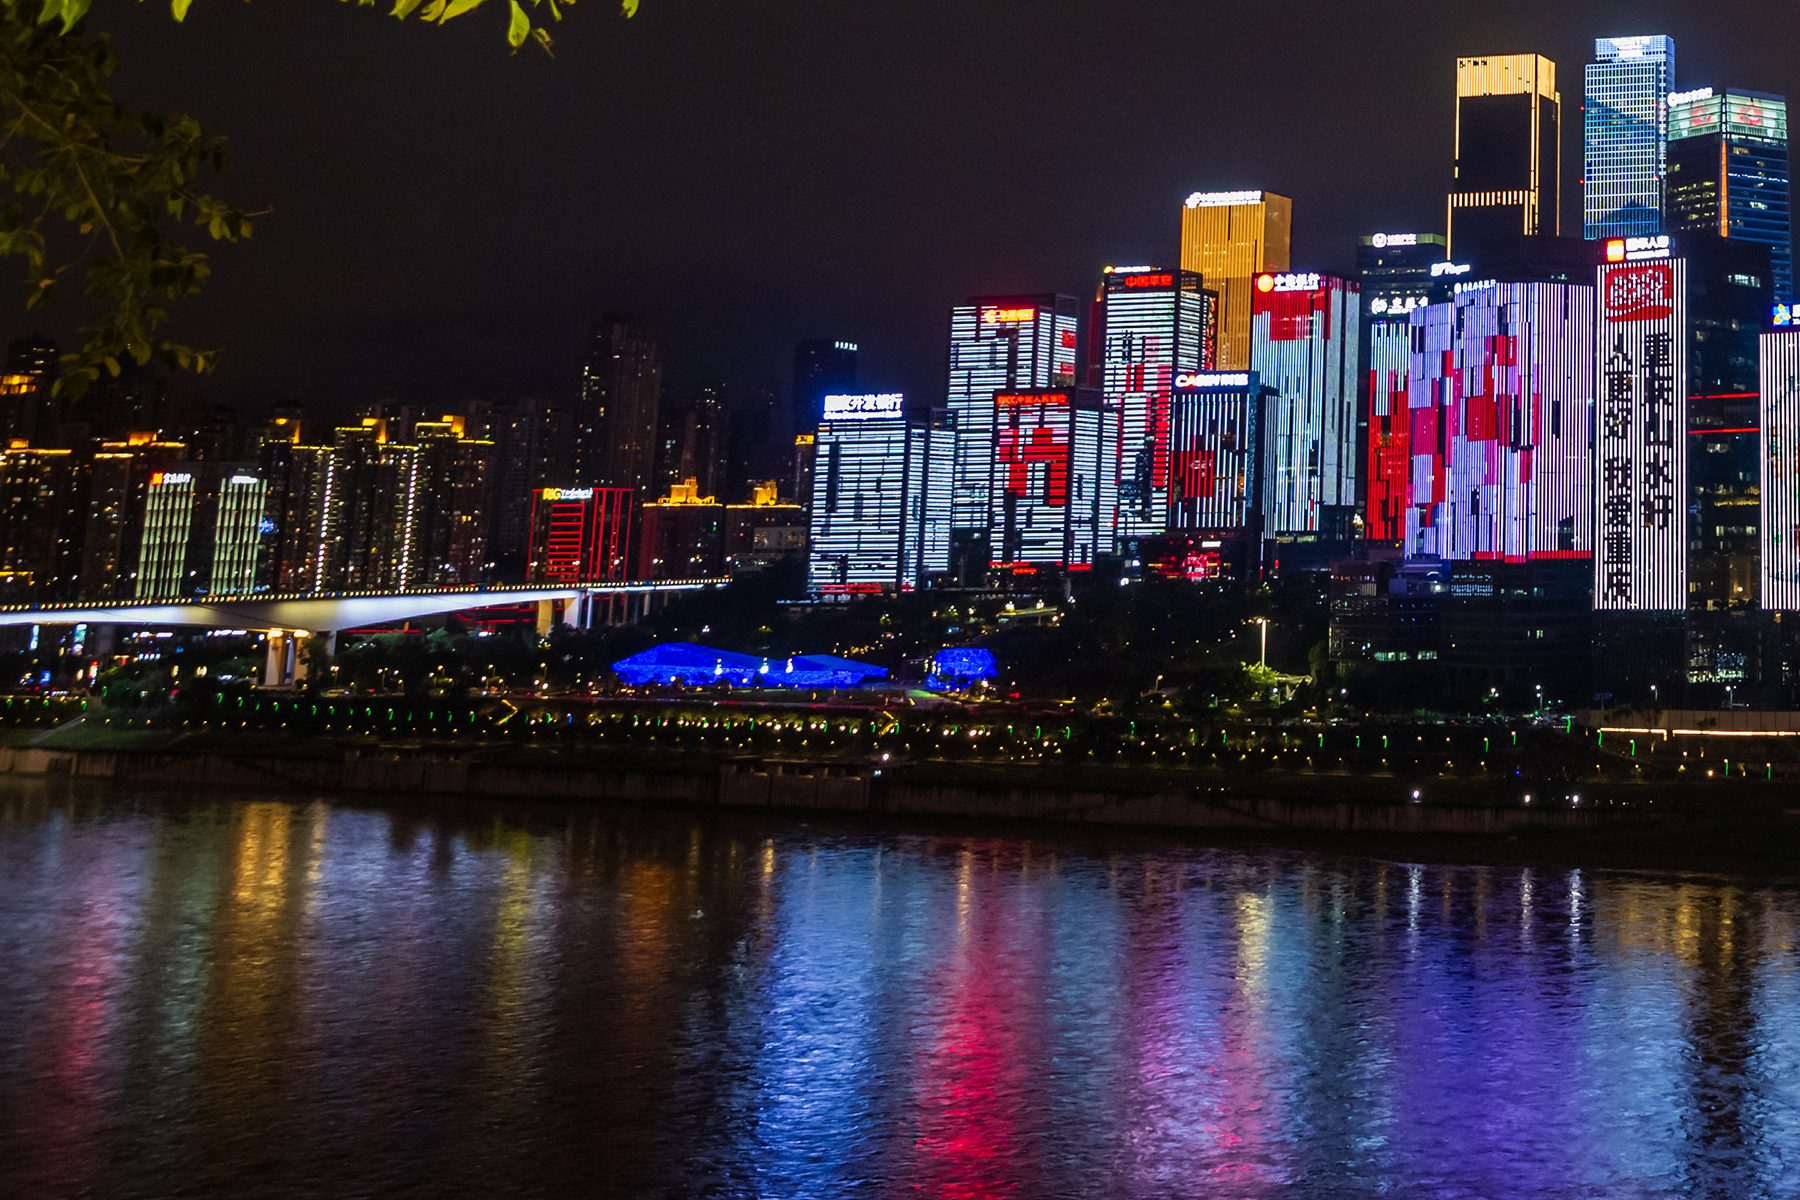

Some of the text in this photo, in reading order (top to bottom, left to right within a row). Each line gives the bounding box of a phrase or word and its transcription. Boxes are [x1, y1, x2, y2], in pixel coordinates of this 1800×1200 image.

[1124, 274, 1173, 288] 中国平安
[1604, 457, 1632, 602] 我爱重庆
